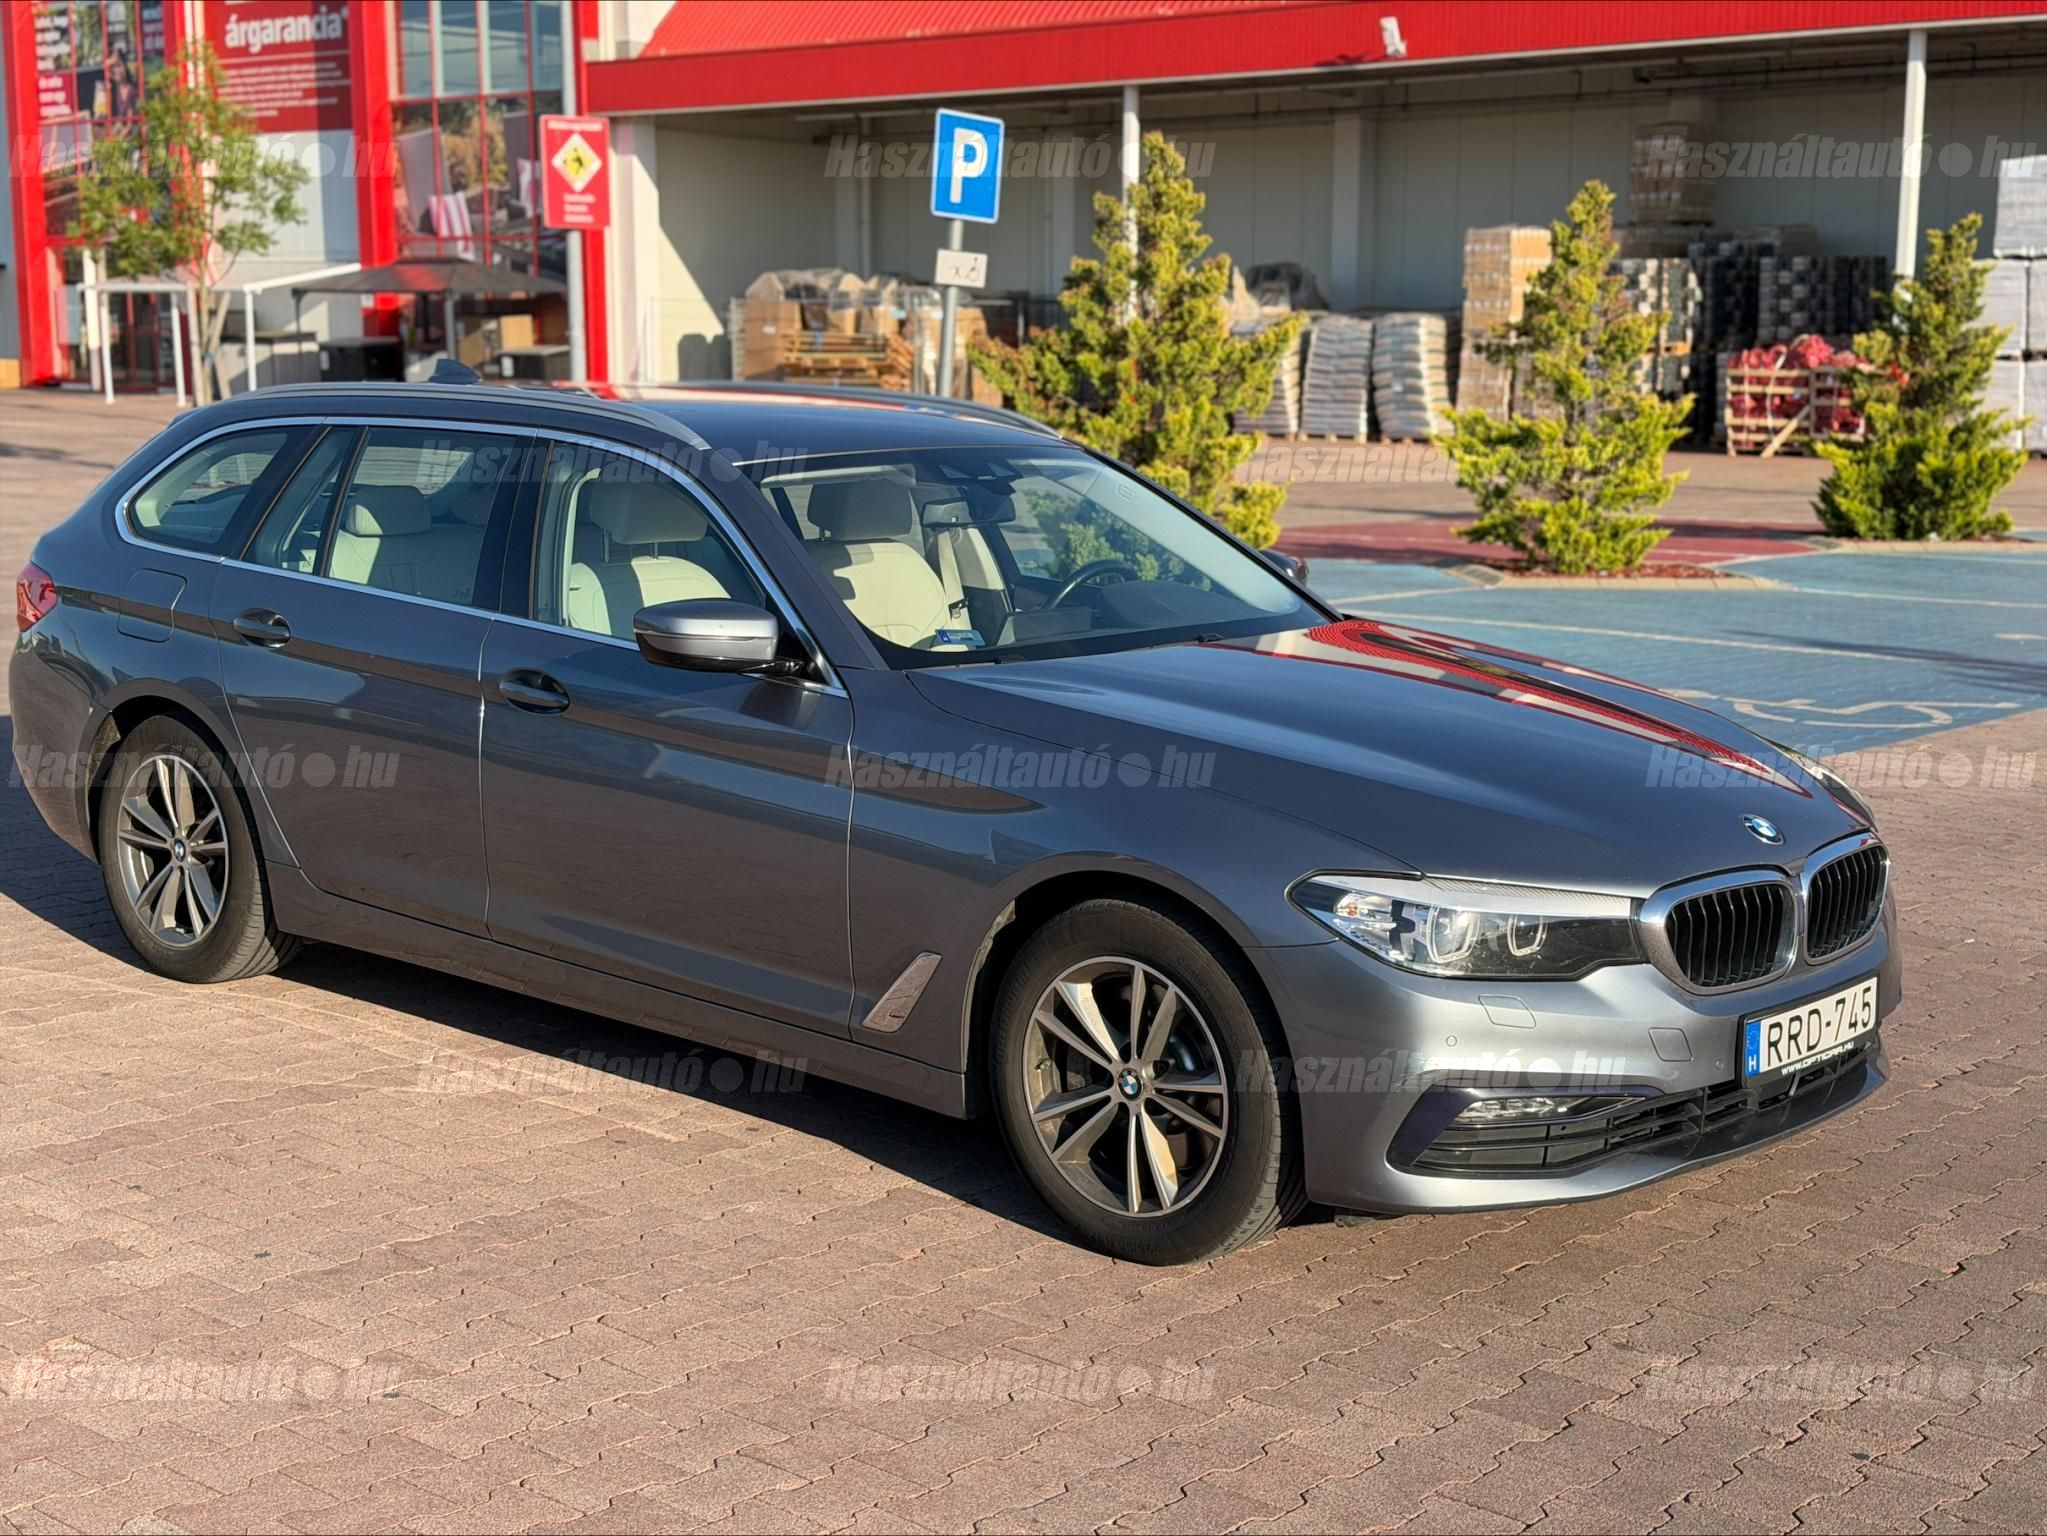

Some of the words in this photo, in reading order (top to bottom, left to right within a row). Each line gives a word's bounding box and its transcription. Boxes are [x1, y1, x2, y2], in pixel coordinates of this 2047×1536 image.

[950, 127, 989, 204] P
[1748, 1055, 1757, 1072] H
[1767, 985, 1873, 1067] RRD-745
